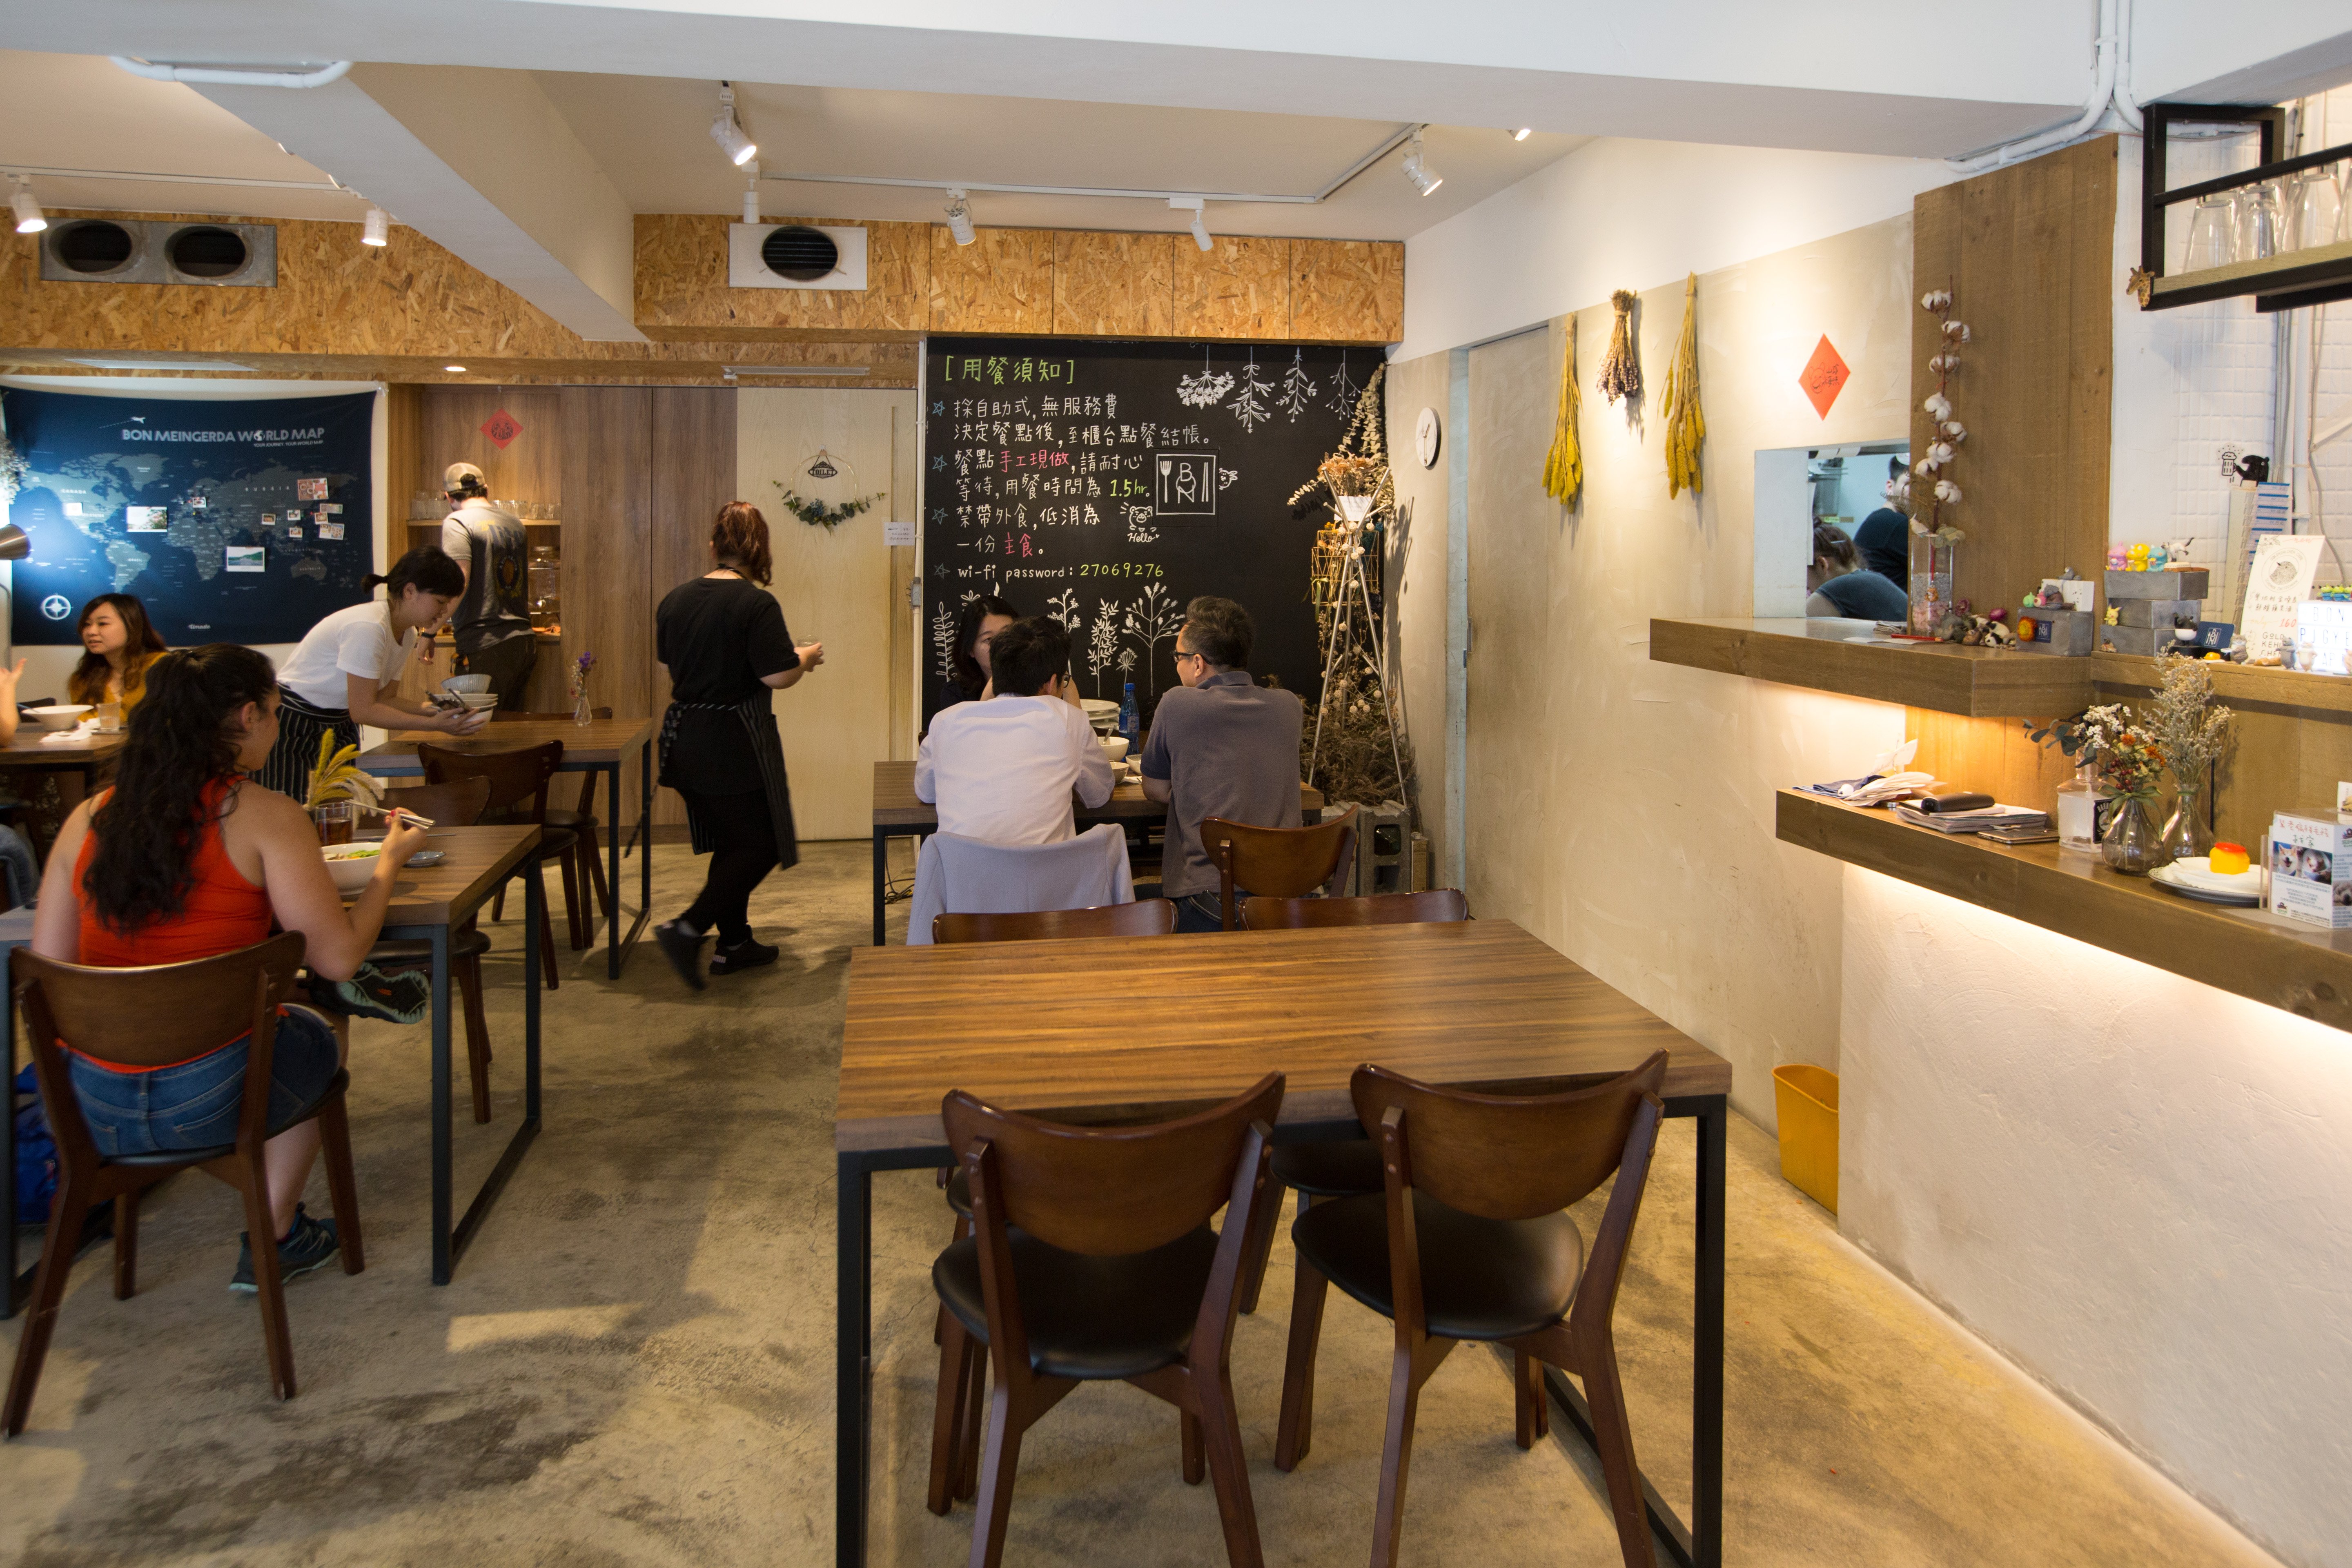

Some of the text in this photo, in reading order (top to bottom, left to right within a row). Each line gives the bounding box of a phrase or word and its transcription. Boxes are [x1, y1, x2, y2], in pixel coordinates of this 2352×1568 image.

[945, 355, 1074, 385] [用餐須知]
[122, 429, 153, 441] BON
[154, 431, 236, 442] MEINGERDA
[291, 428, 325, 439] MAP
[1127, 532, 1156, 542] Hello
[958, 564, 996, 580] wi-fi
[1080, 563, 1163, 578] 27069276
[2280, 618, 2297, 628] 160
[2262, 632, 2284, 640] GOLD
